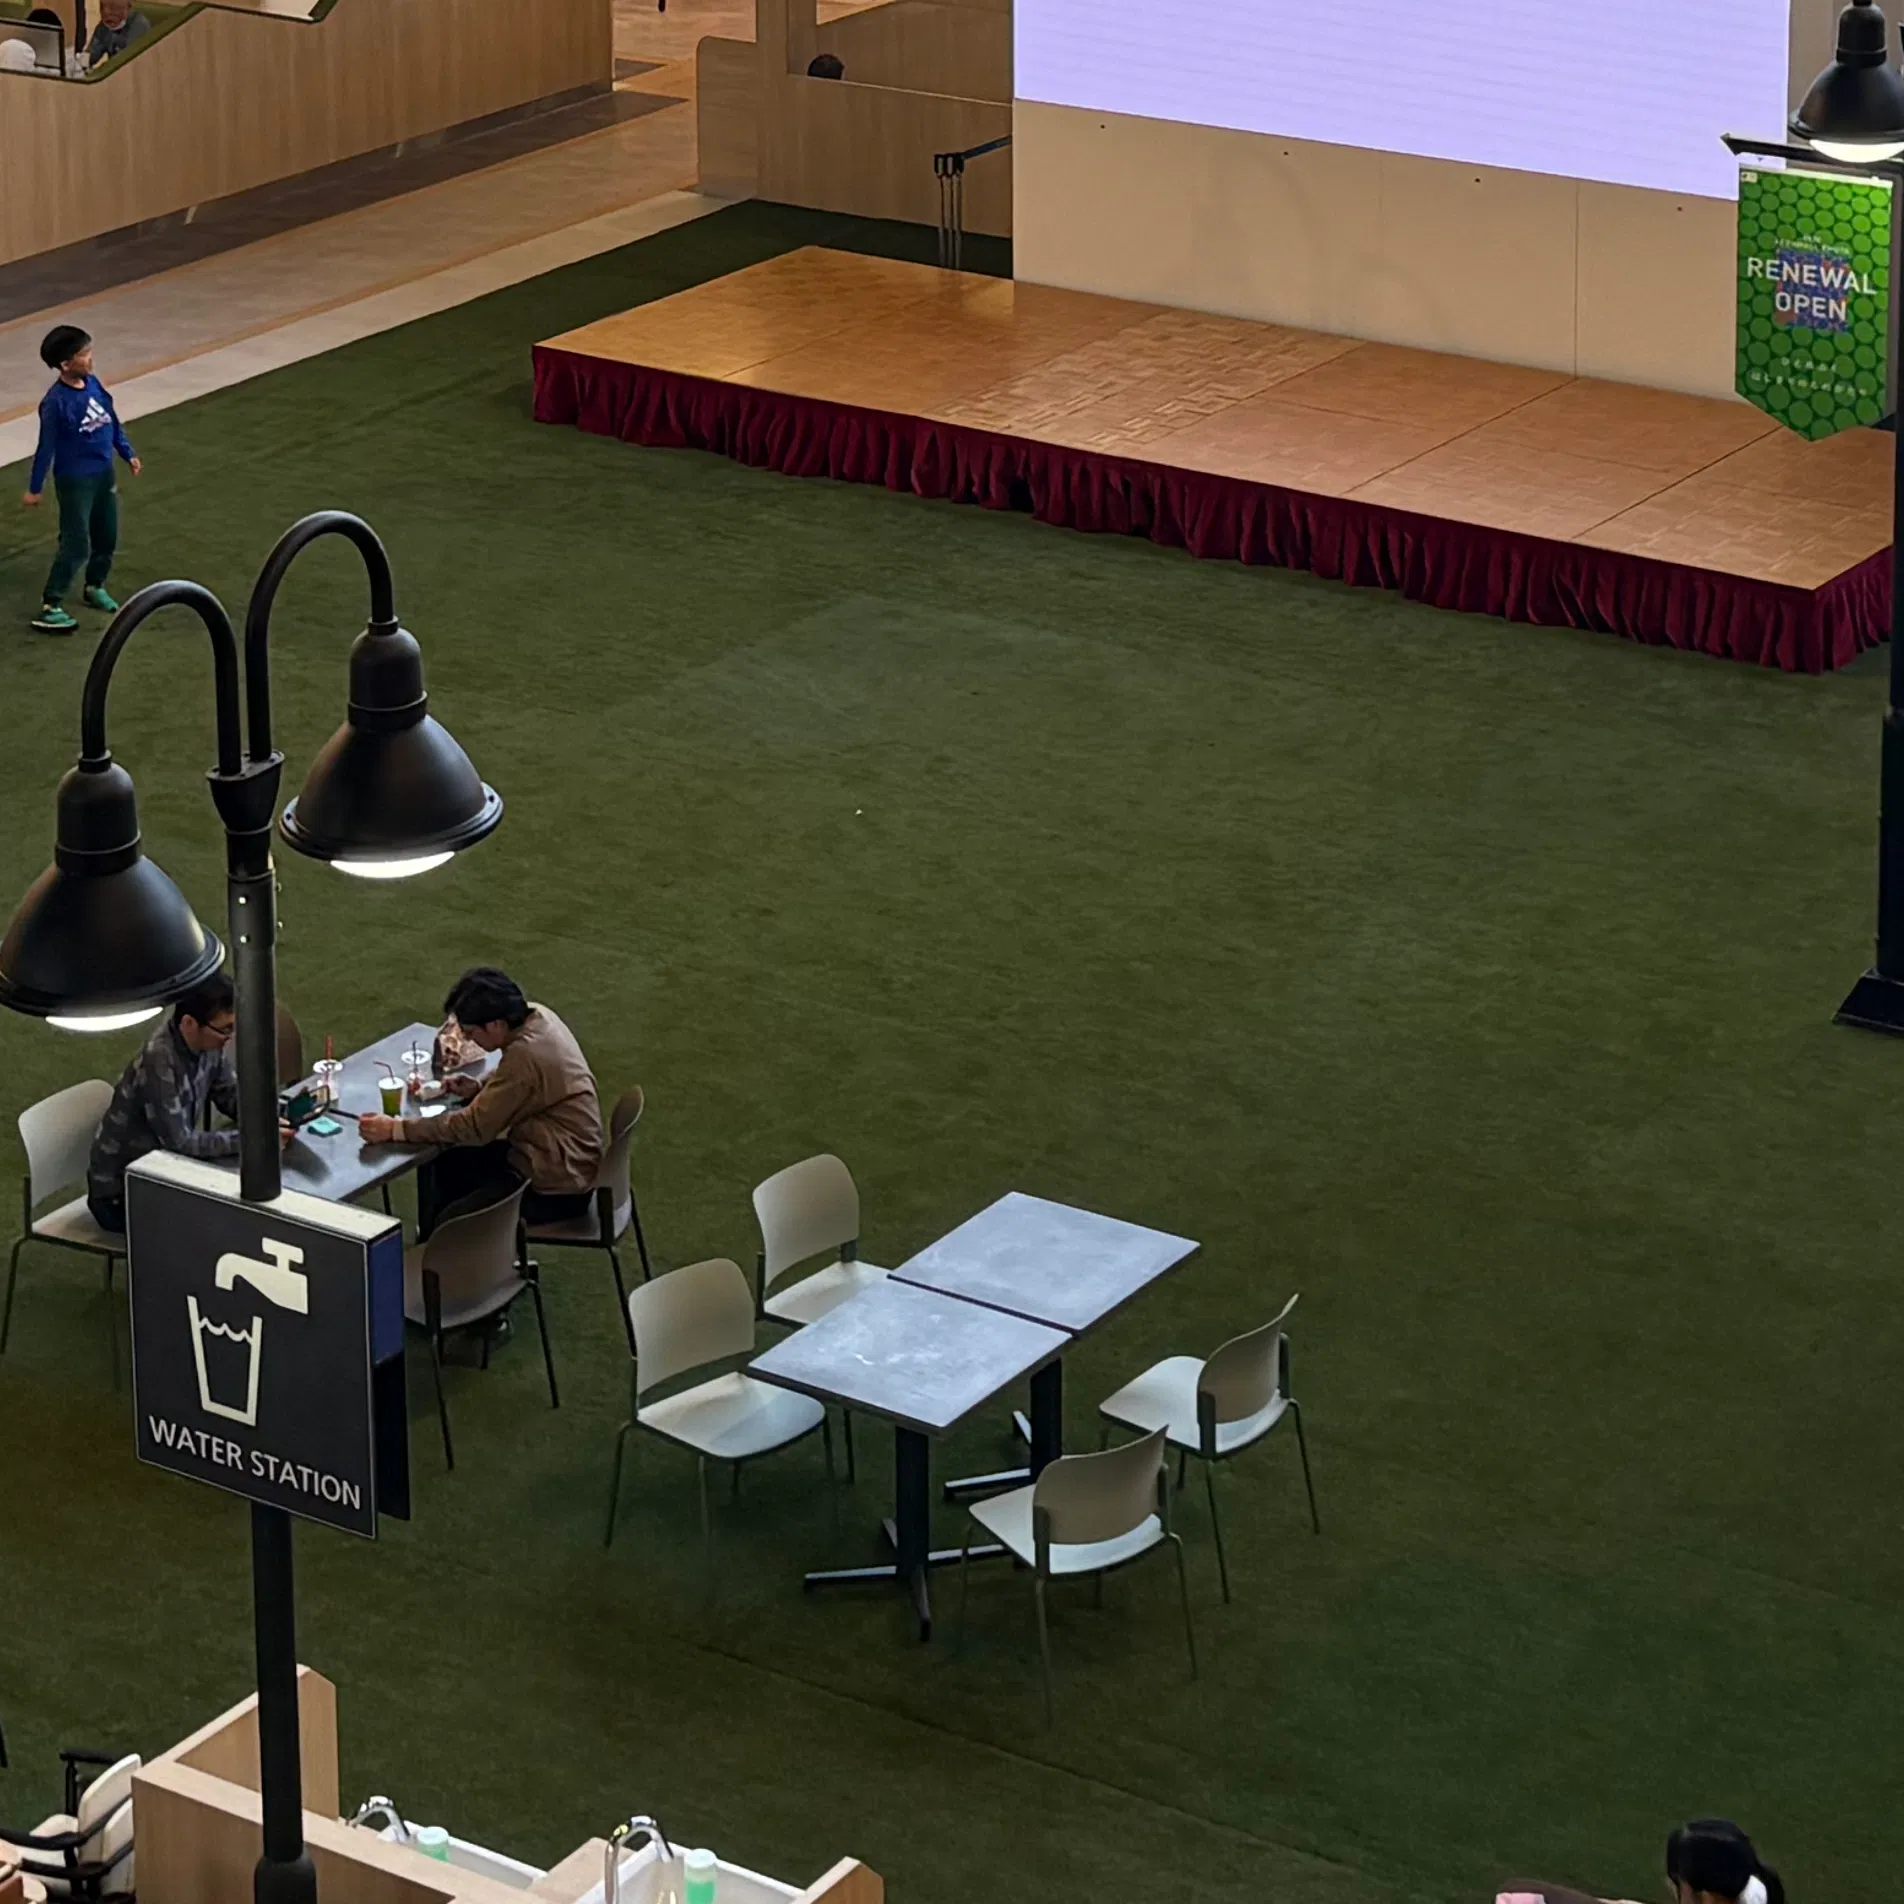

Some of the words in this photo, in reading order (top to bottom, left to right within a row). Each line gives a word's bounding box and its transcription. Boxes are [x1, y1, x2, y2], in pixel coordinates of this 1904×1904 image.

[1747, 256, 1878, 296] RENEWAL
[1775, 291, 1846, 322] OPEN
[148, 1414, 244, 1472] WATER
[249, 1449, 361, 1511] STATION
